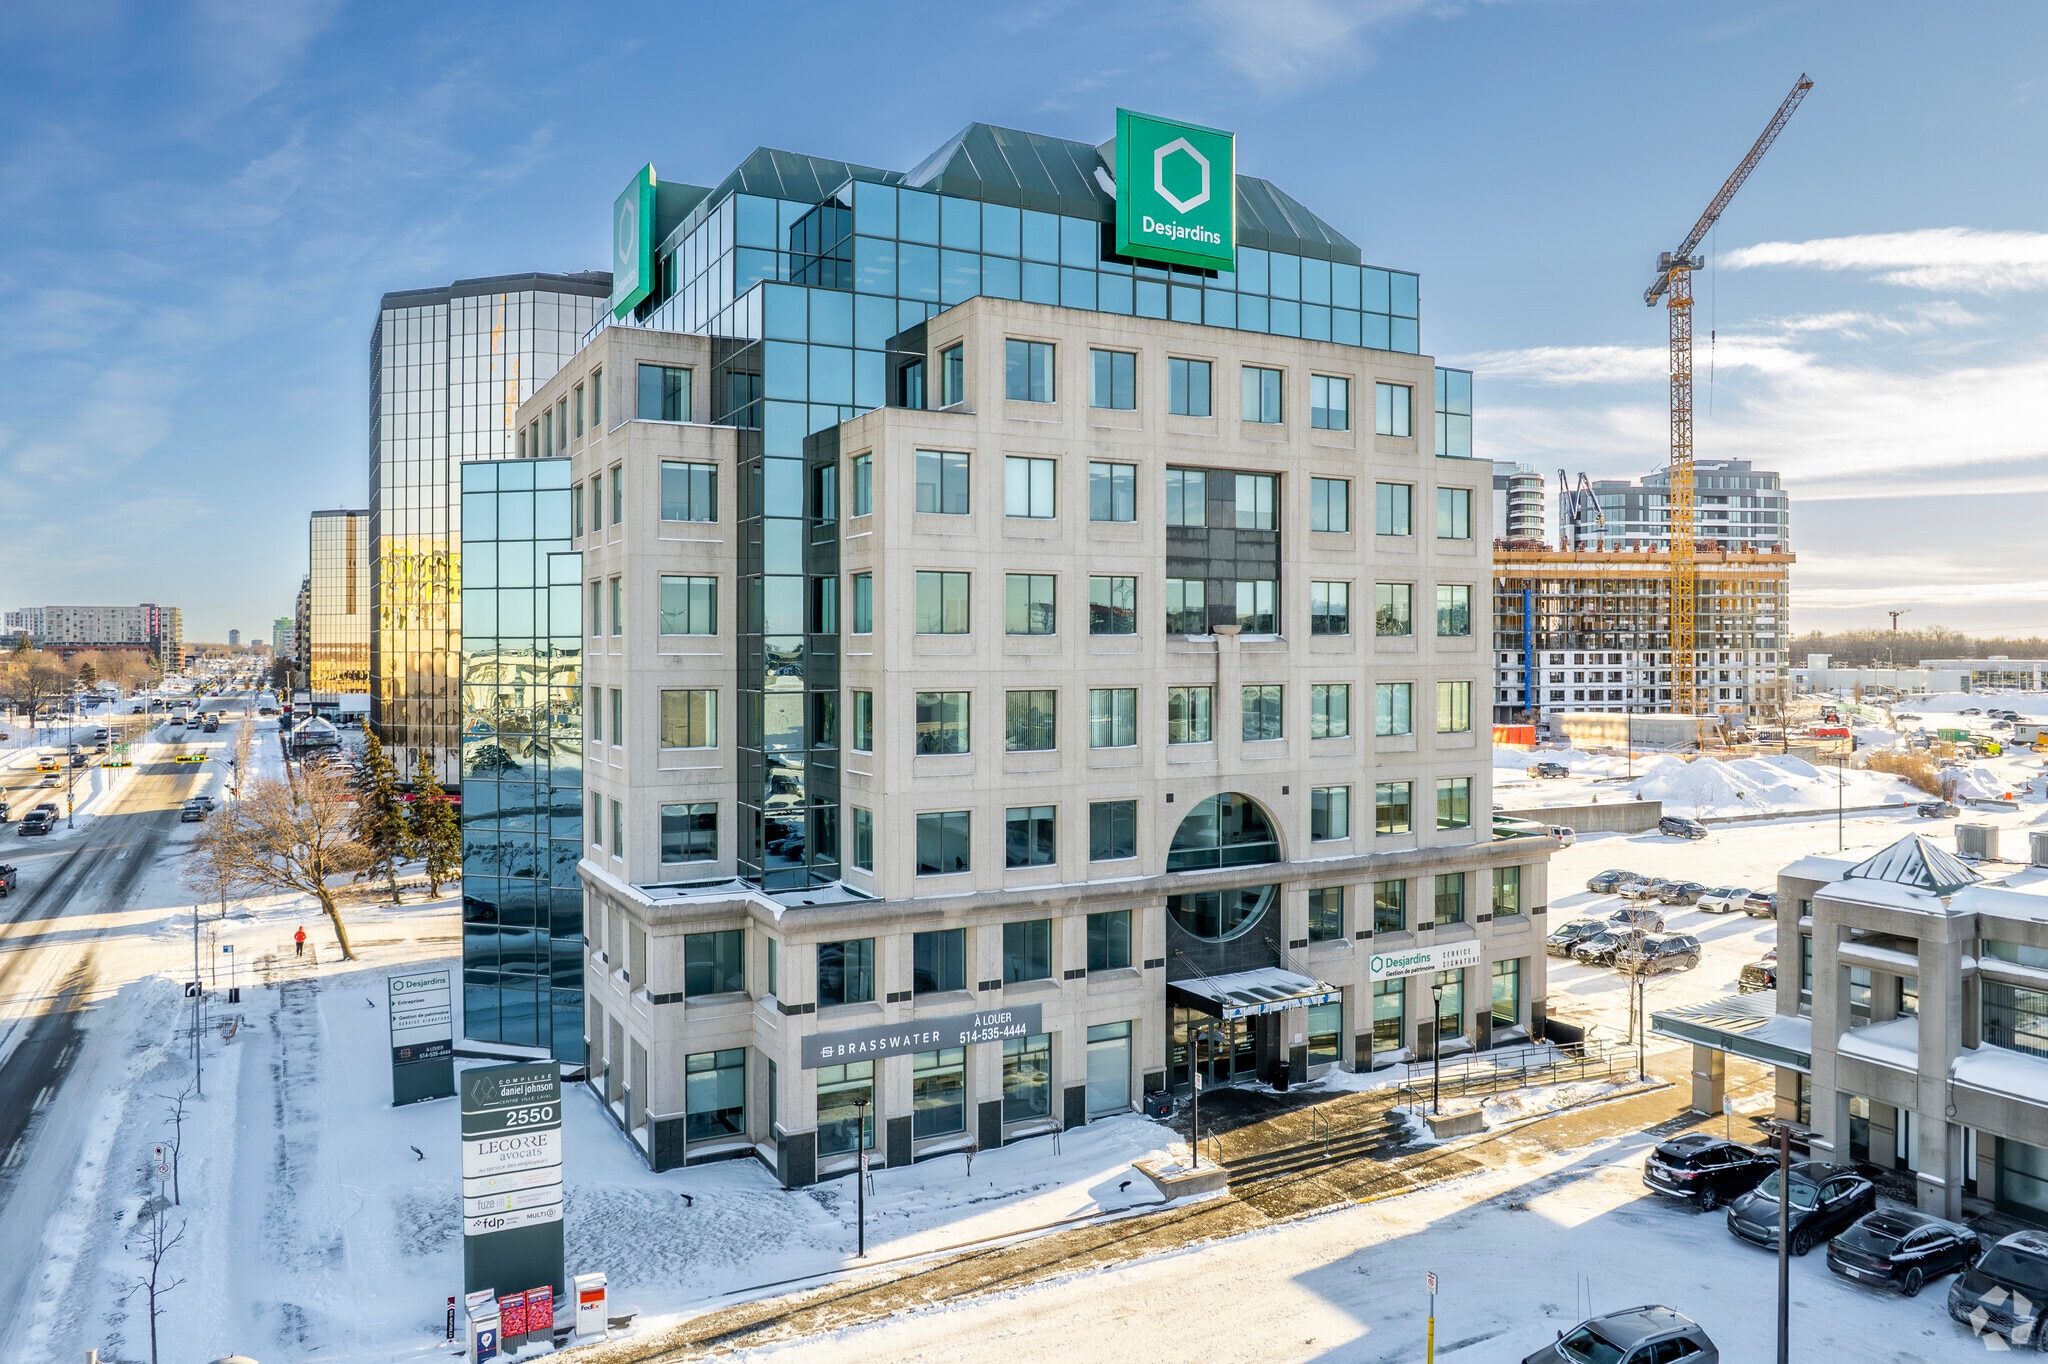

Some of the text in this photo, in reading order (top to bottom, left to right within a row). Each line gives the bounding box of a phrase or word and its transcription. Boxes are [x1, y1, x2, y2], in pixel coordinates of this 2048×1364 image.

[1142, 215, 1221, 245] Desjardins
[1443, 948, 1471, 959] SERVICE
[1385, 953, 1431, 969] Desjardins
[1442, 956, 1480, 969] SIGNATURE
[1385, 969, 1404, 978] Gestion
[1411, 964, 1435, 975] patrimoine
[406, 977, 446, 988] Desjardins
[397, 998, 425, 1006] Entreprises
[974, 1012, 1012, 1027] À LOUER
[959, 1022, 1027, 1044] 514-535-4444
[837, 1031, 941, 1057] BRASSWATER
[498, 1073, 552, 1085] COMPLEXE
[501, 1083, 553, 1097] daniel johnson
[506, 1106, 553, 1126] 2550
[478, 1134, 548, 1156] LECORRE
[499, 1147, 543, 1161] avocats
[486, 1164, 506, 1173] service
[477, 1198, 495, 1211] fuze
[482, 1217, 506, 1229] fdp
[580, 1303, 600, 1311] FedEx
